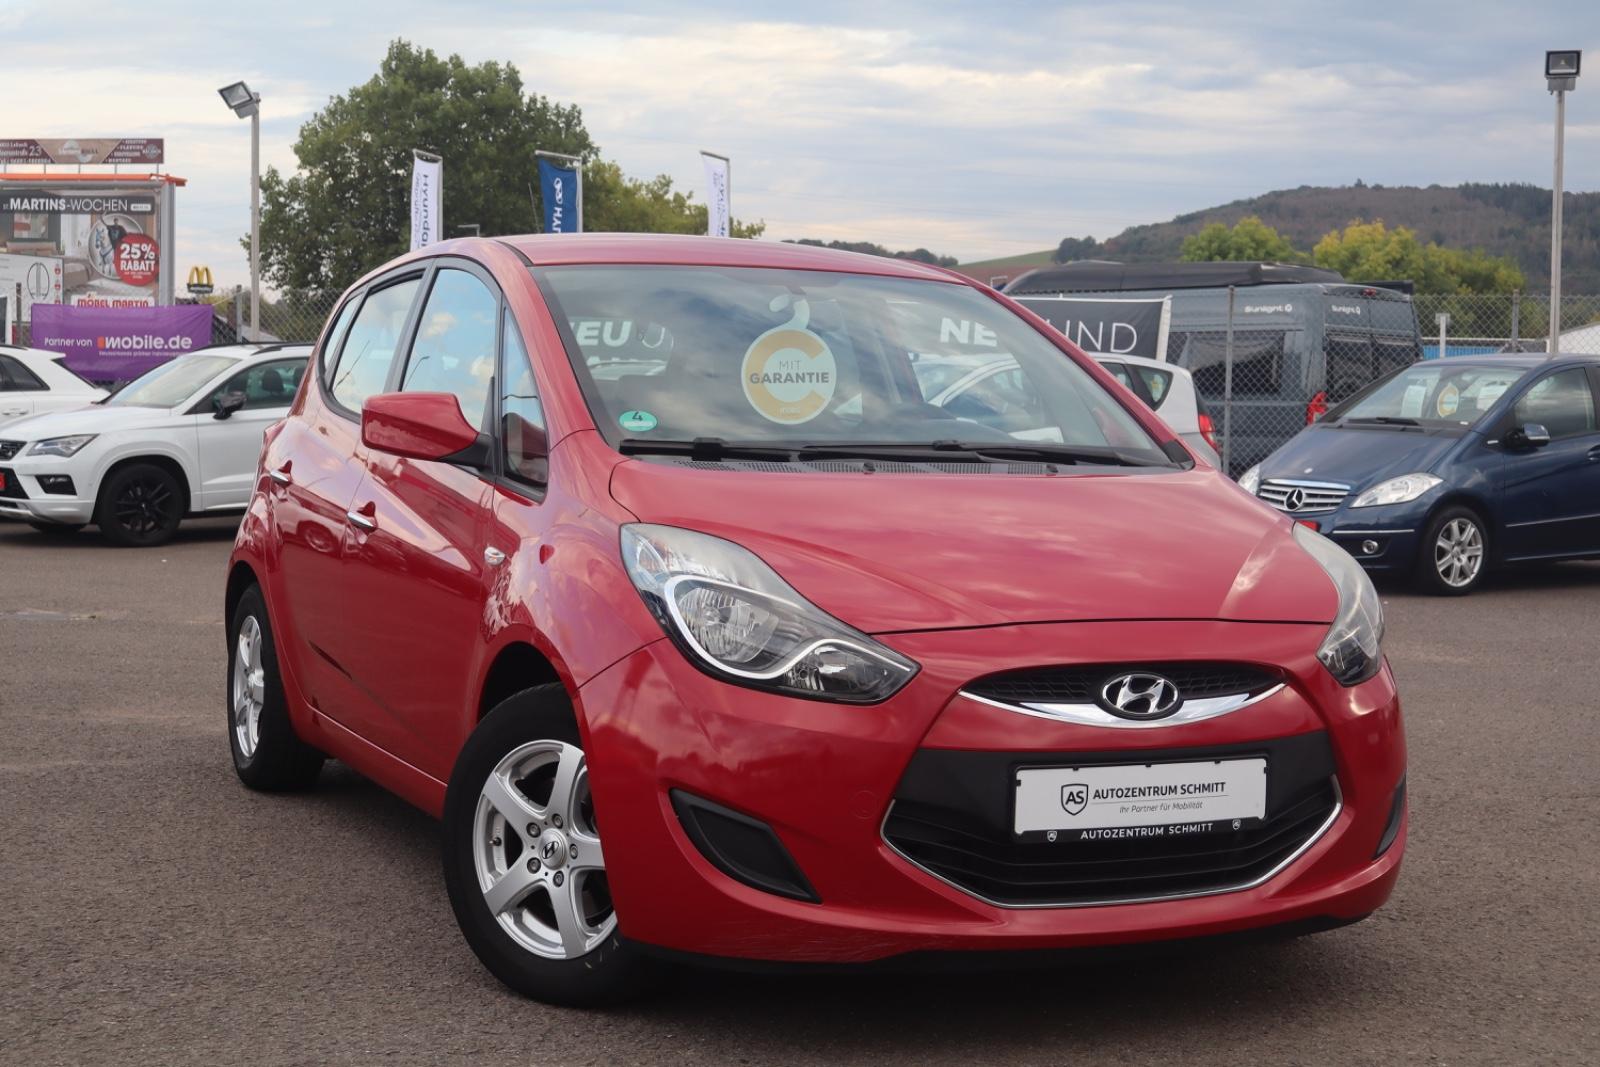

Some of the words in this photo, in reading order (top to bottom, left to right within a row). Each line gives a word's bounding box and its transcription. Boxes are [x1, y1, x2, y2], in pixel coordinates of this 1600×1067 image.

[10, 198, 128, 211] MARTINS-WOCHEN
[421, 174, 431, 247] Hyundai
[120, 243, 155, 259] 25%
[120, 260, 155, 271] RABATT
[569, 321, 632, 348] EU
[44, 337, 74, 346] Partner
[76, 338, 93, 347] von
[105, 335, 193, 349] mobile.de
[779, 360, 800, 371] MIT
[750, 372, 829, 384] GARANTIE
[631, 411, 643, 421] 4
[1092, 785, 1178, 799] AUTOZENTRUM
[1180, 781, 1226, 795] SCHMITT
[1065, 790, 1085, 805] AS
[1119, 806, 1129, 814] Ihr
[1131, 803, 1158, 813] Partner
[1159, 802, 1171, 811] für
[1172, 801, 1203, 810] Mobilität
[1080, 827, 1165, 840] AUTOZENTRUM
[1168, 823, 1214, 834] SCHMITT
